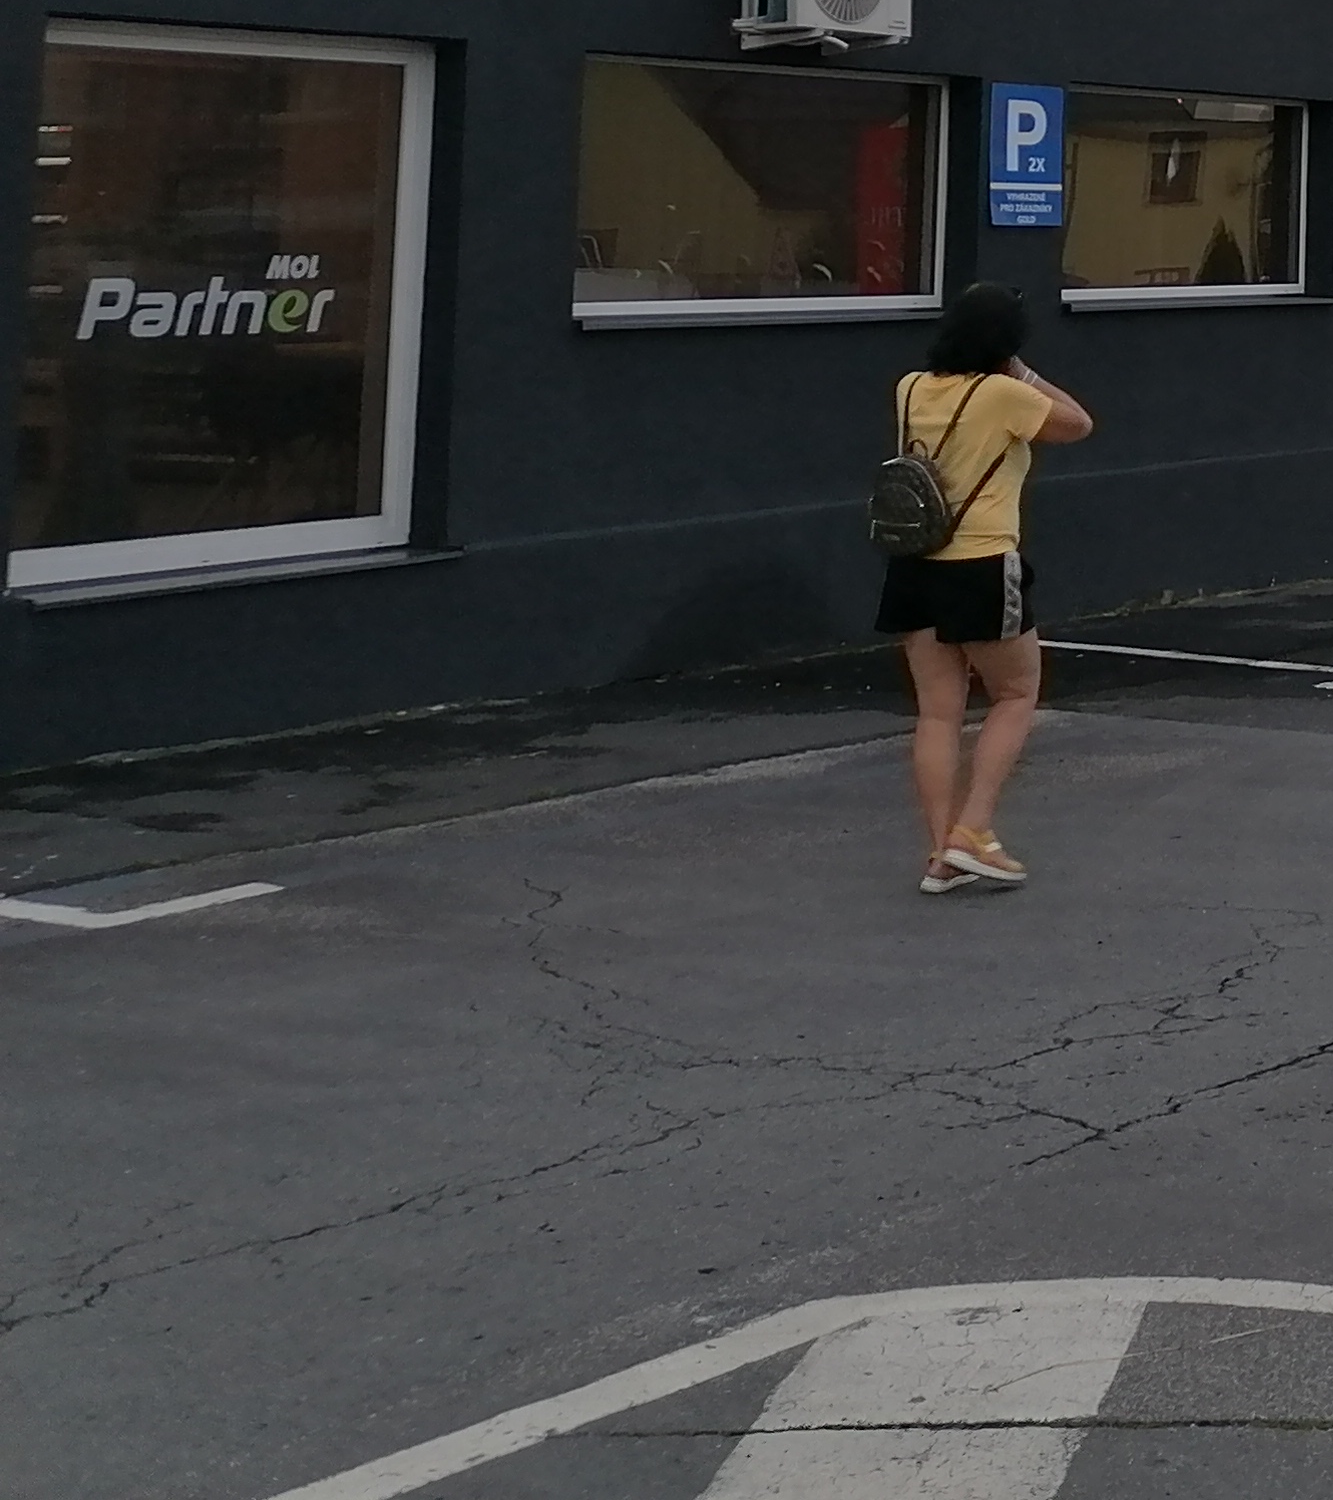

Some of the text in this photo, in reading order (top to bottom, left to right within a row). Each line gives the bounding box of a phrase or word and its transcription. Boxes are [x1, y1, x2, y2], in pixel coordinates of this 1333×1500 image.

[1006, 99, 1047, 172] P
[266, 255, 321, 280] MOL
[76, 275, 337, 341] Partner
